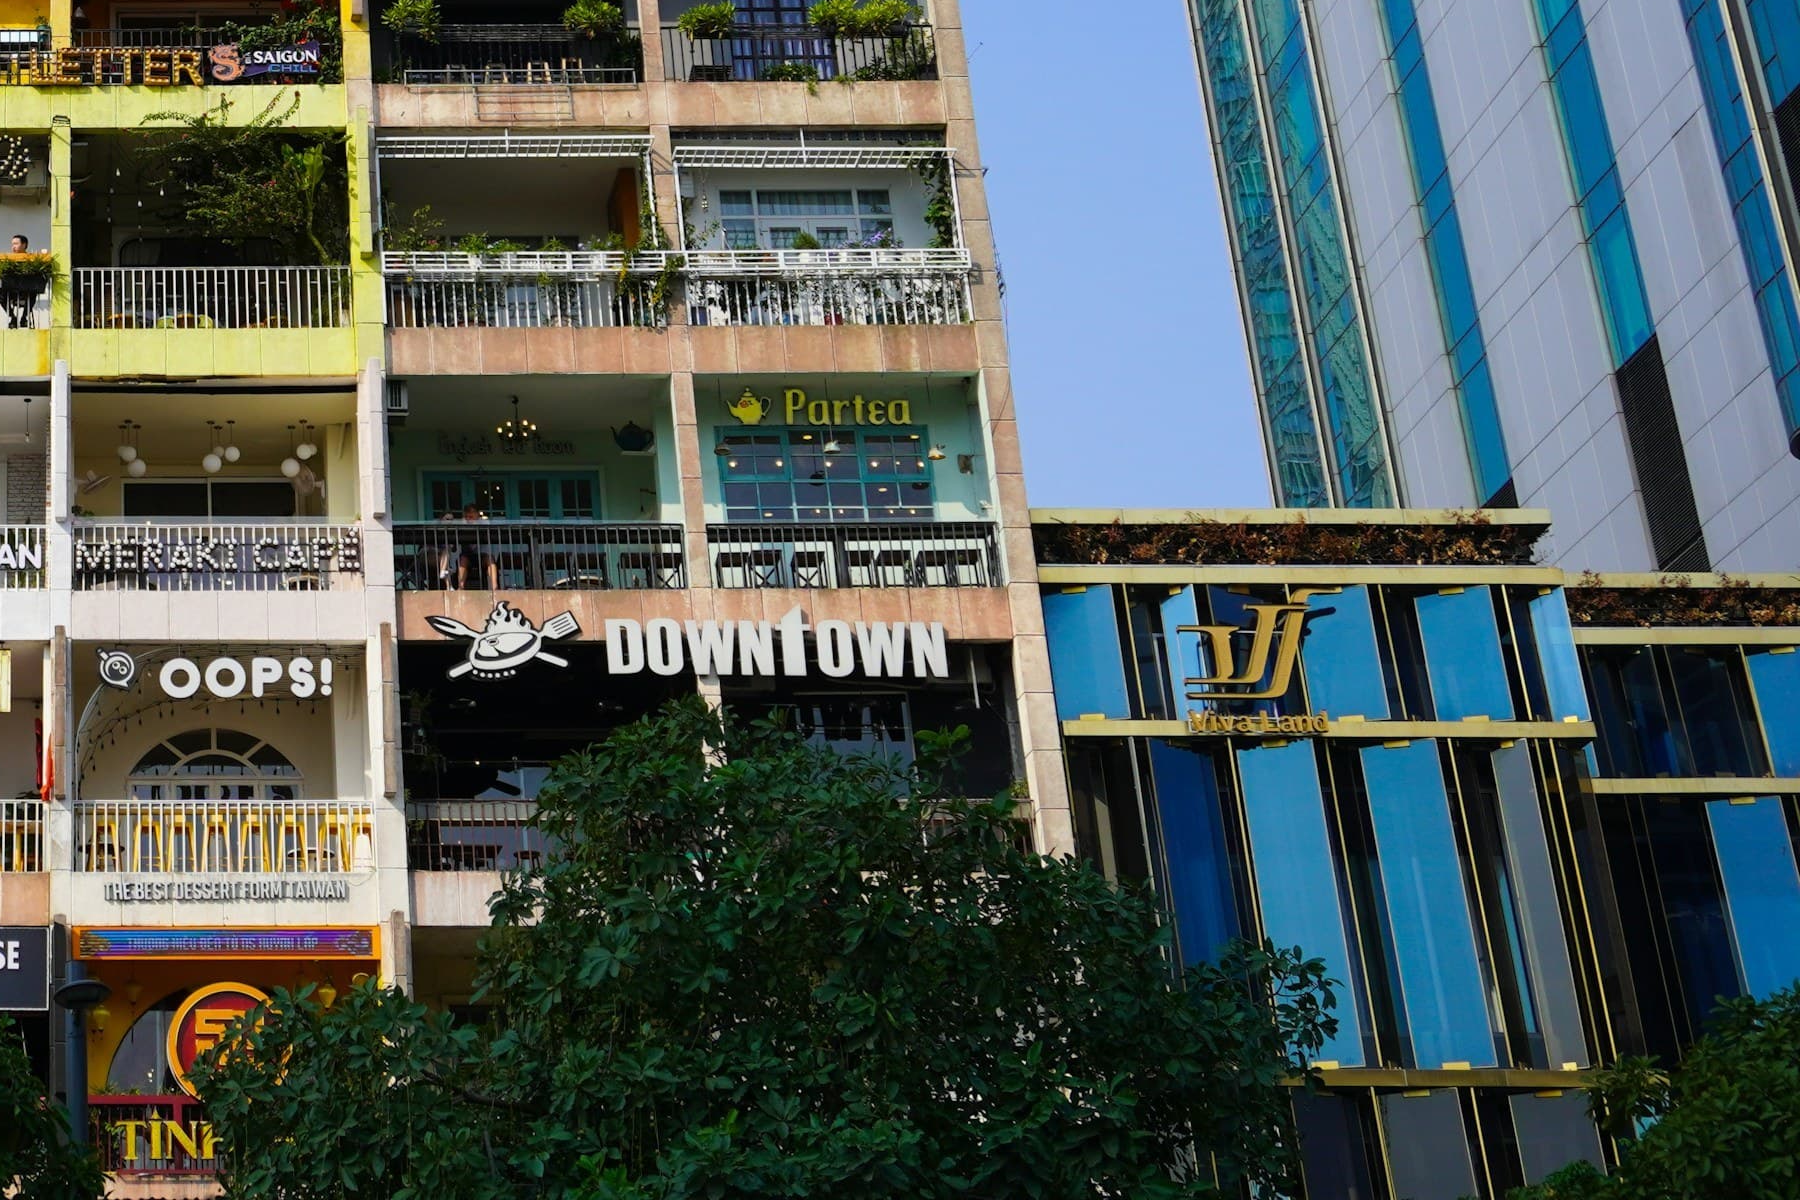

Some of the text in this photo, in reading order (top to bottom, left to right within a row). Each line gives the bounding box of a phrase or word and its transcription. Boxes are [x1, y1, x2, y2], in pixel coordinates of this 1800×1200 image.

[29, 47, 204, 87] LETTER
[253, 50, 317, 64] SAIGON
[267, 64, 318, 73] CHILL
[784, 388, 913, 426] Partea
[75, 537, 238, 571] MERAKI
[159, 657, 333, 699] OOPS!
[1188, 709, 1329, 733] Viva Land
[104, 880, 348, 900] THE BEST DESSERT FORM TAIWAN
